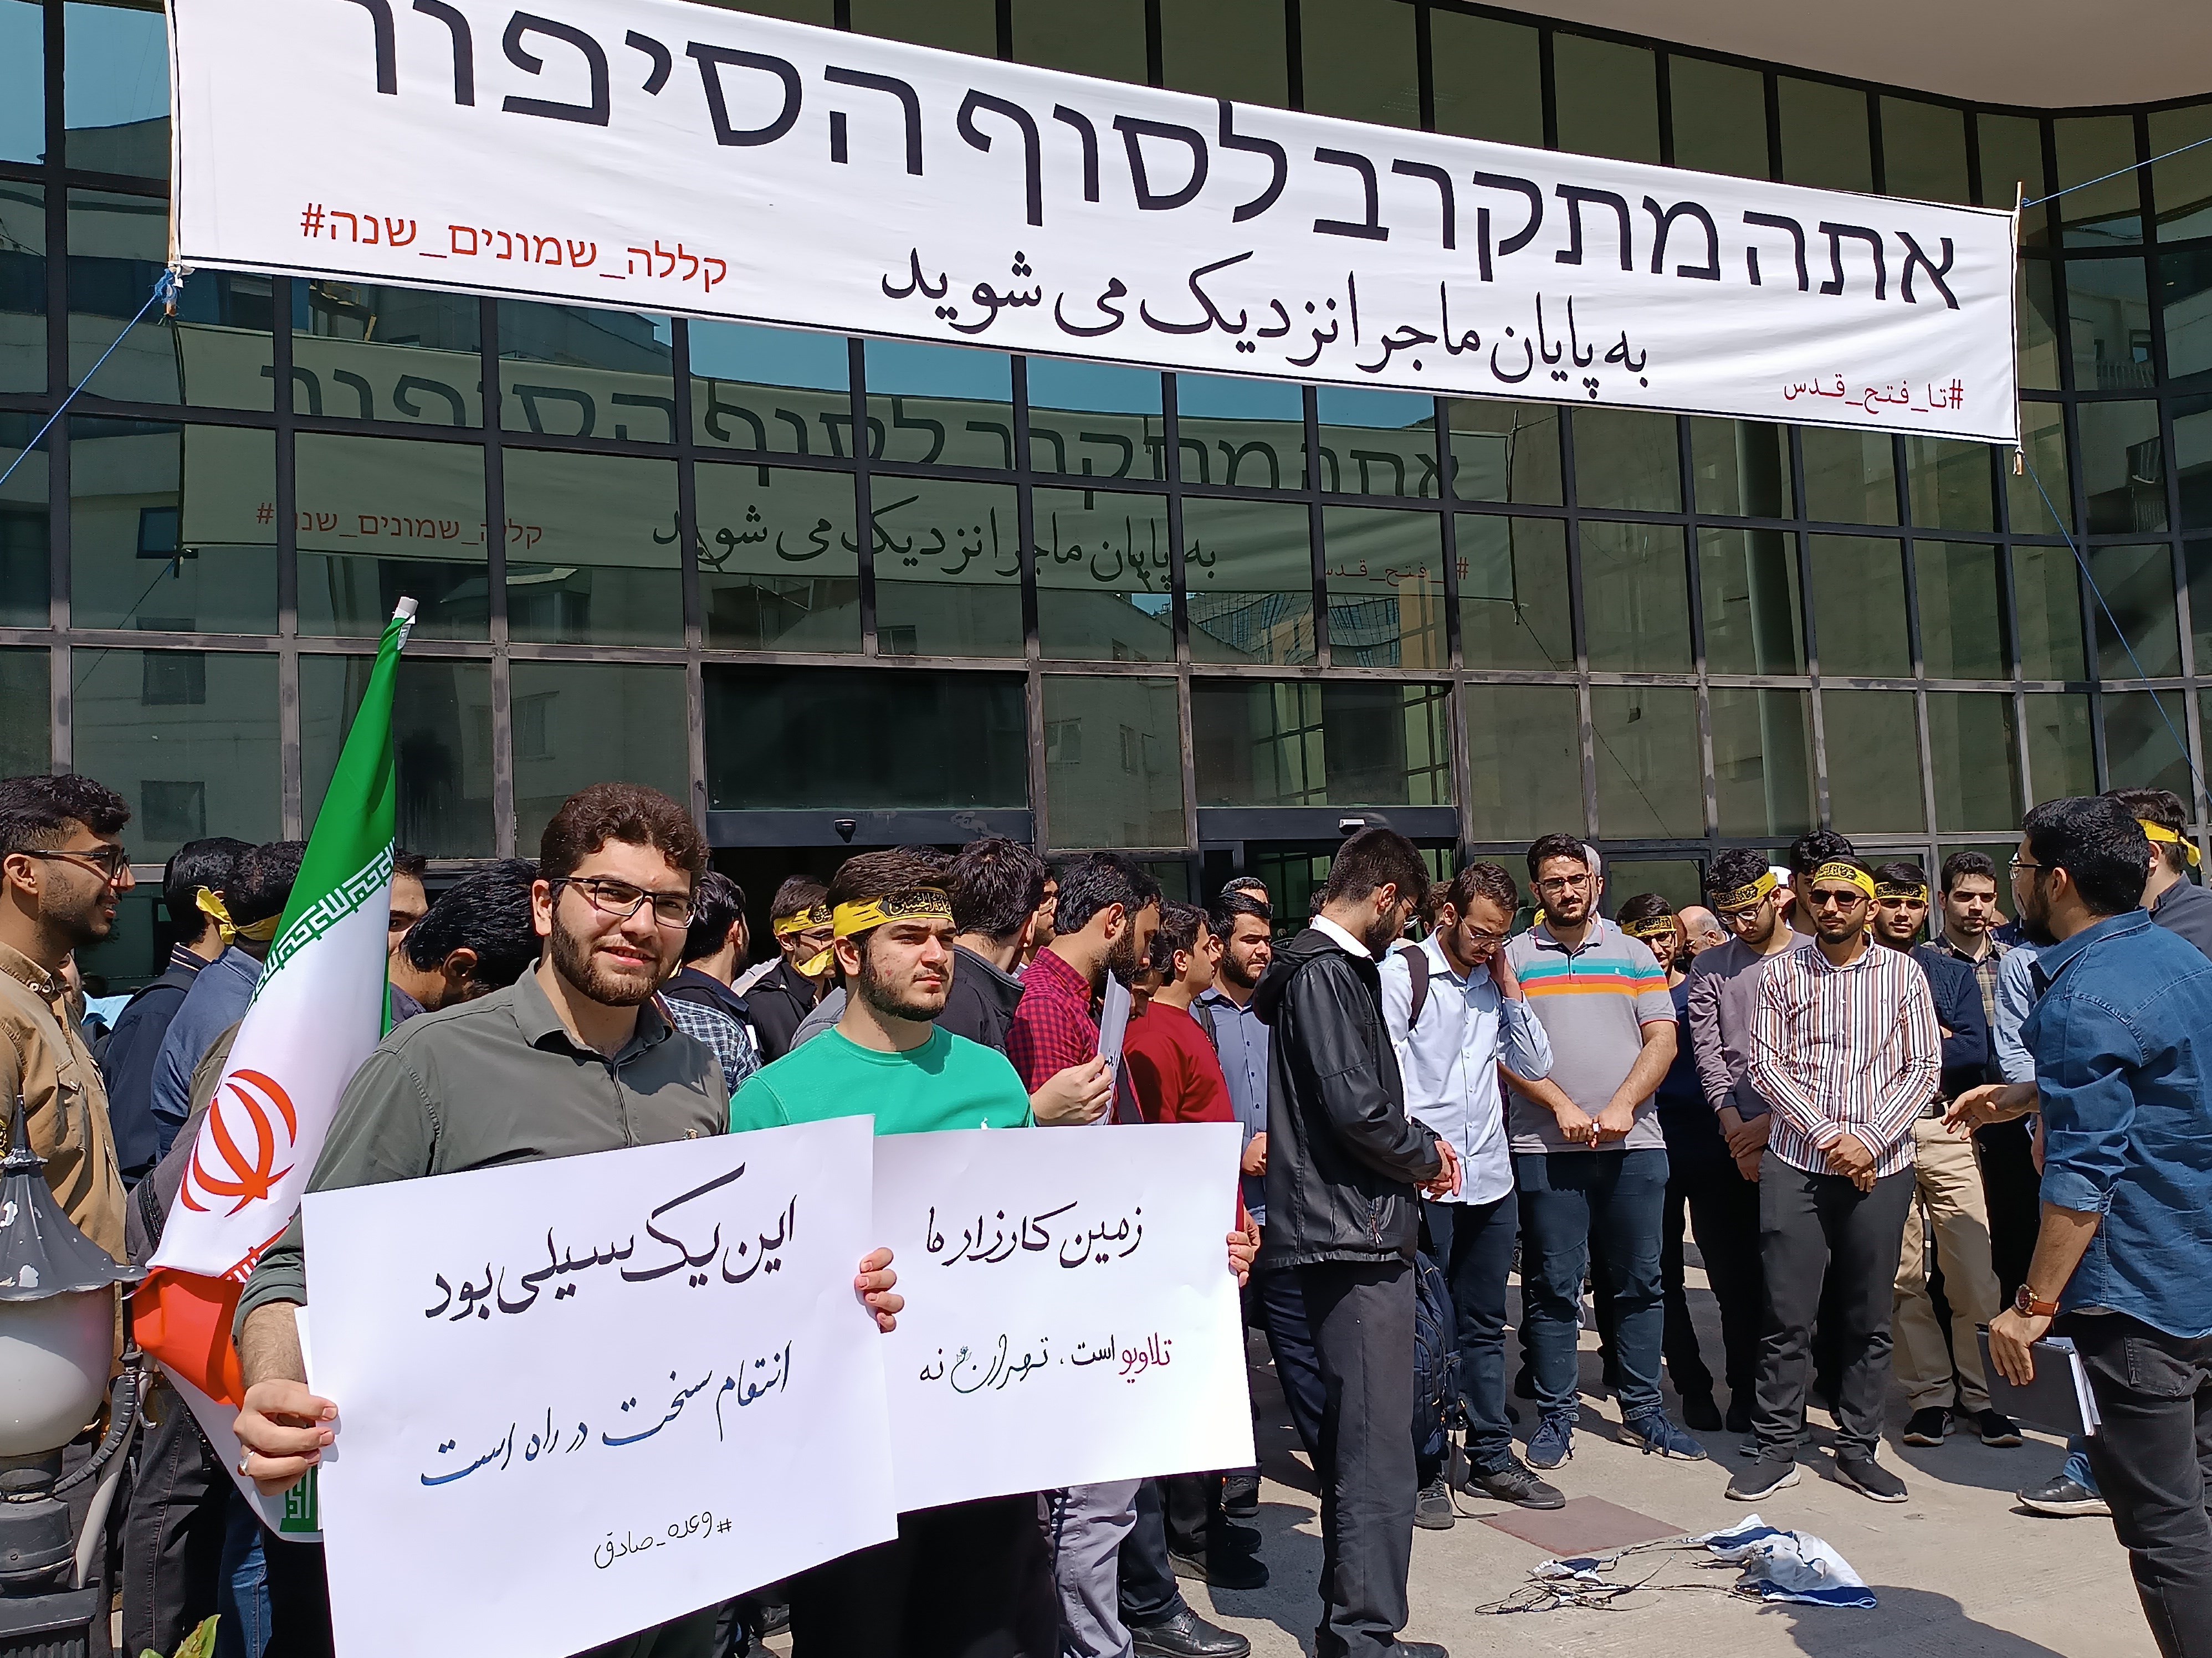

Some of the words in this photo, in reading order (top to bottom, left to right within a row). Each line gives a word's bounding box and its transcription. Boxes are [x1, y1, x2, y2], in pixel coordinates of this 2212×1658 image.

[344, 0, 923, 176] הסיפור
[957, 88, 1287, 227] לסוף
[1313, 147, 1720, 282] מתקרב
[882, 248, 1041, 334] شوید
[1743, 211, 1960, 310] אתה
[1054, 278, 1127, 337] می
[1140, 251, 1338, 367] نزدیک
[1348, 271, 1480, 373] ماجرا
[1491, 292, 1599, 399] پایان
[1604, 328, 1648, 388] به
[776, 519, 832, 561] می
[1185, 538, 1216, 579] به
[621, 1162, 745, 1288] یک
[723, 1194, 797, 1285] این
[1060, 1207, 1142, 1268] زمین
[426, 1262, 493, 1321] بود
[498, 1227, 633, 1313] سیلی
[716, 1340, 792, 1441] انتقام
[920, 1348, 944, 1380] نه
[951, 1335, 1048, 1393] تهران
[525, 1407, 559, 1461] راه
[566, 1423, 587, 1453] در
[602, 1370, 712, 1446] سخت
[421, 1423, 515, 1485] است
